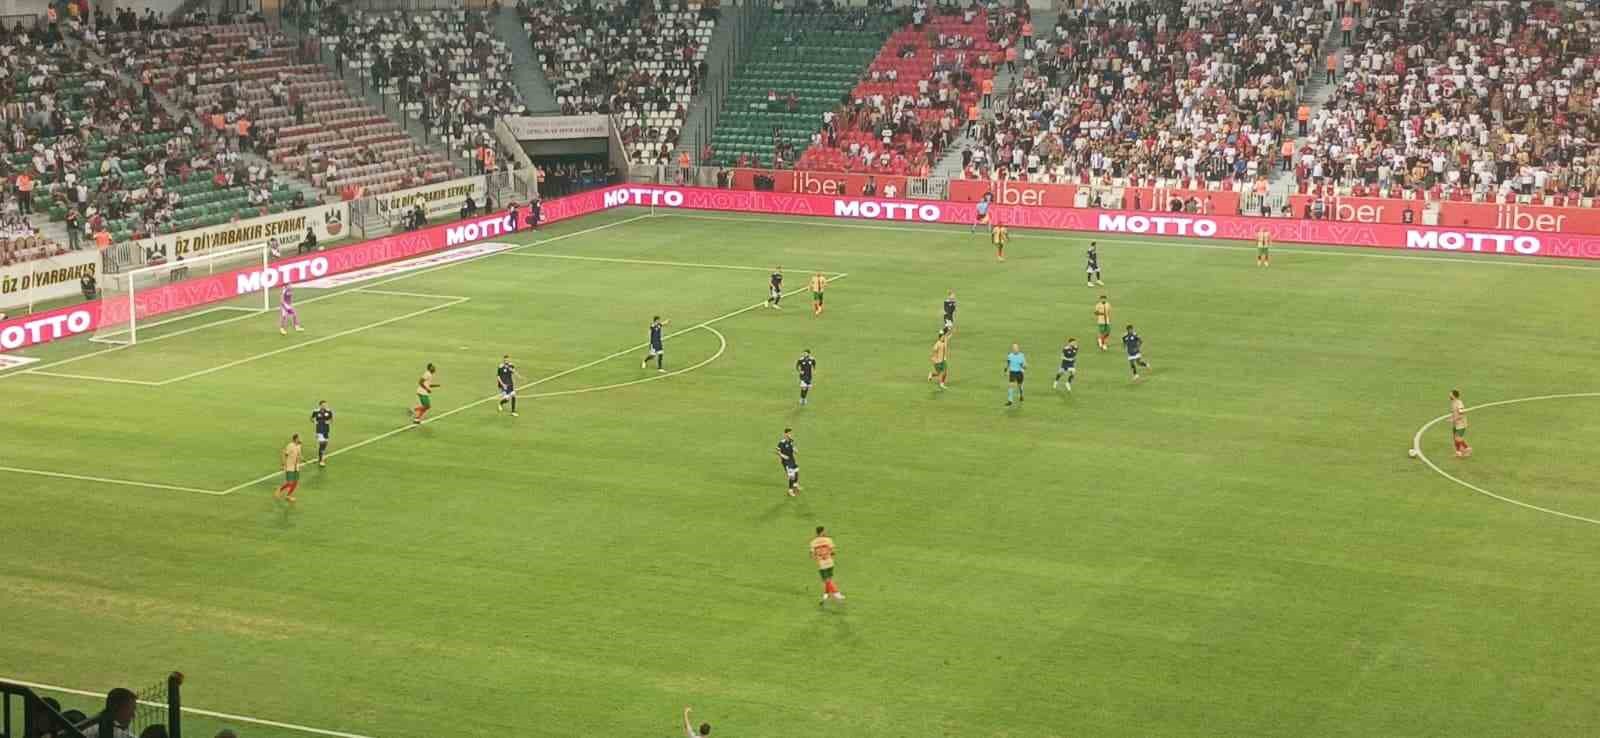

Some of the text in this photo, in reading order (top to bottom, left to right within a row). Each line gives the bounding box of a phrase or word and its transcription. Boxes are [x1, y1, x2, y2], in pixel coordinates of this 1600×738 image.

[265, 215, 306, 237] SEYAHAT
[604, 188, 683, 208] MOTTO
[834, 199, 940, 221] MOTTO
[1098, 214, 1216, 236] MOTTO
[1407, 230, 1540, 254] MOTTO
[0, 310, 91, 349] OTTO
[237, 256, 329, 294] MOTTO
[2, 274, 17, 294] ÖZ
